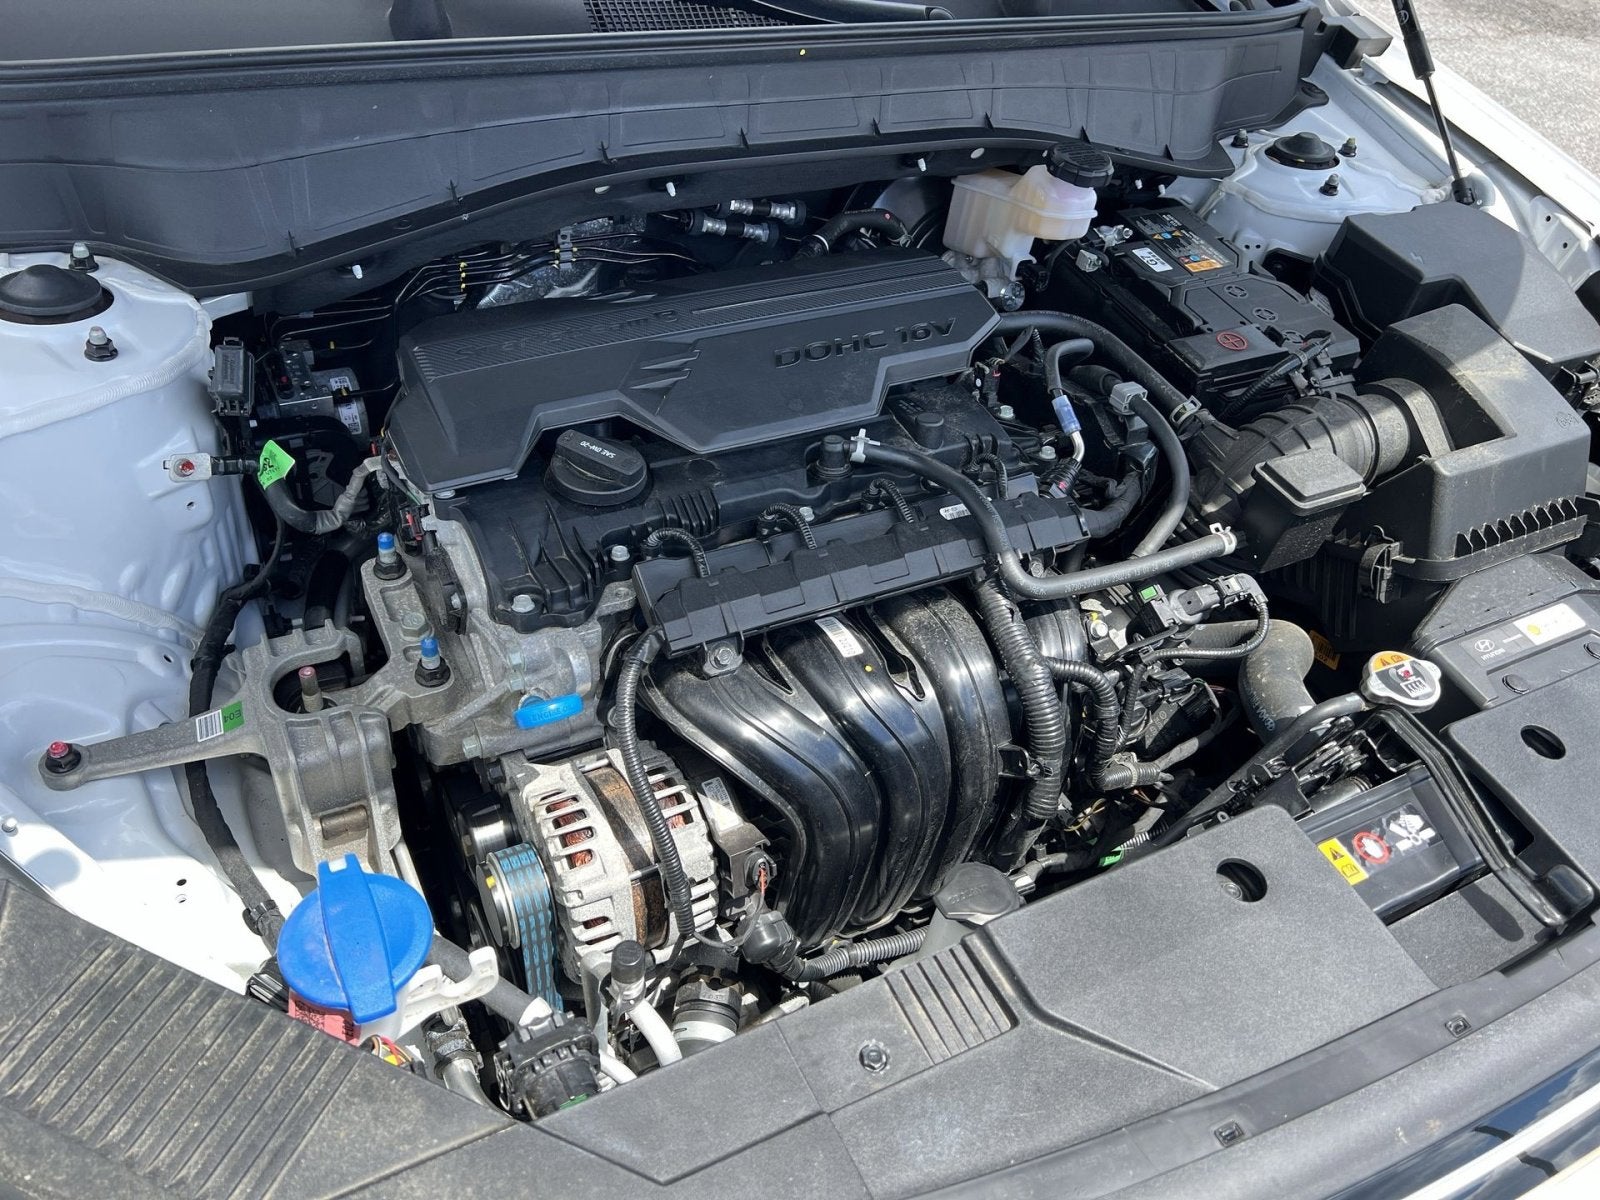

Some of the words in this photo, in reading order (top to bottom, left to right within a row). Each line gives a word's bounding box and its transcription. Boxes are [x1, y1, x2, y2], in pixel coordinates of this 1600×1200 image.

[774, 330, 888, 369] DOHC
[895, 317, 956, 344] 16V
[600, 449, 616, 458] SAE
